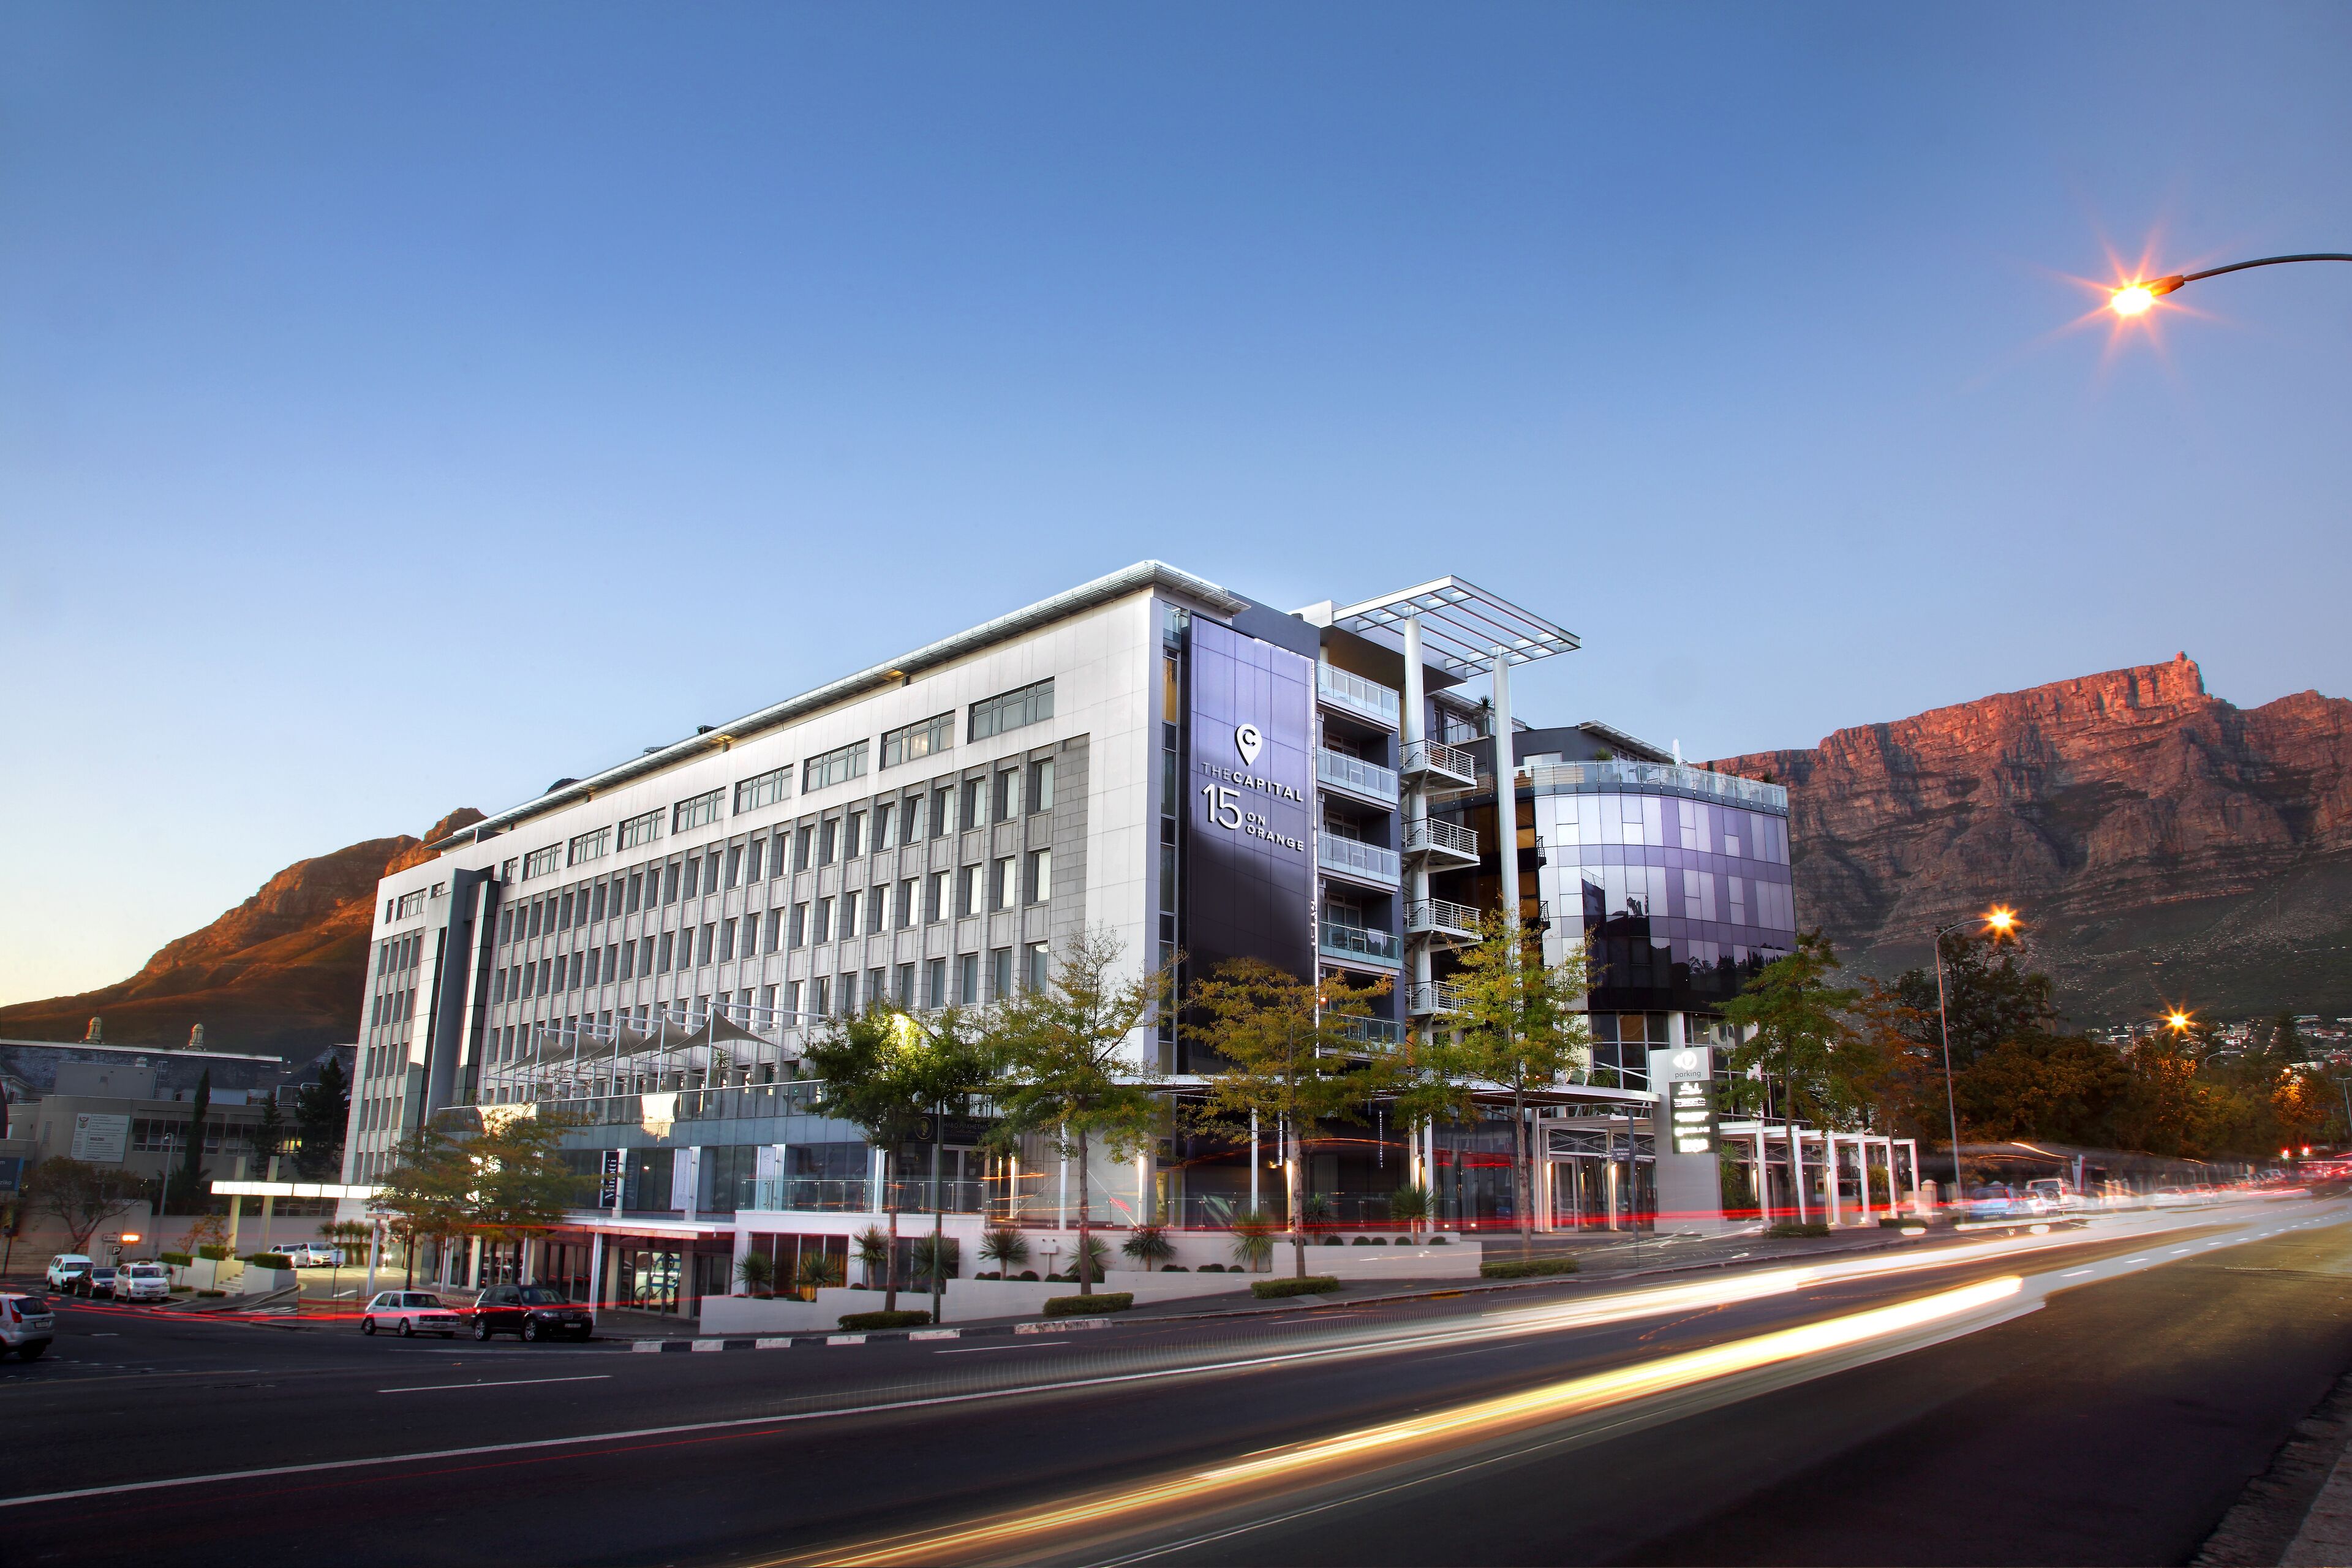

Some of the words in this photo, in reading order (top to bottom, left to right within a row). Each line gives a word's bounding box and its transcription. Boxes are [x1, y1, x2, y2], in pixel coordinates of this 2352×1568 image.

[1202, 783, 1242, 829] 15
[1246, 812, 1265, 826] ON
[1246, 824, 1303, 851] ORANGE
[1675, 1070, 1701, 1079] parking
